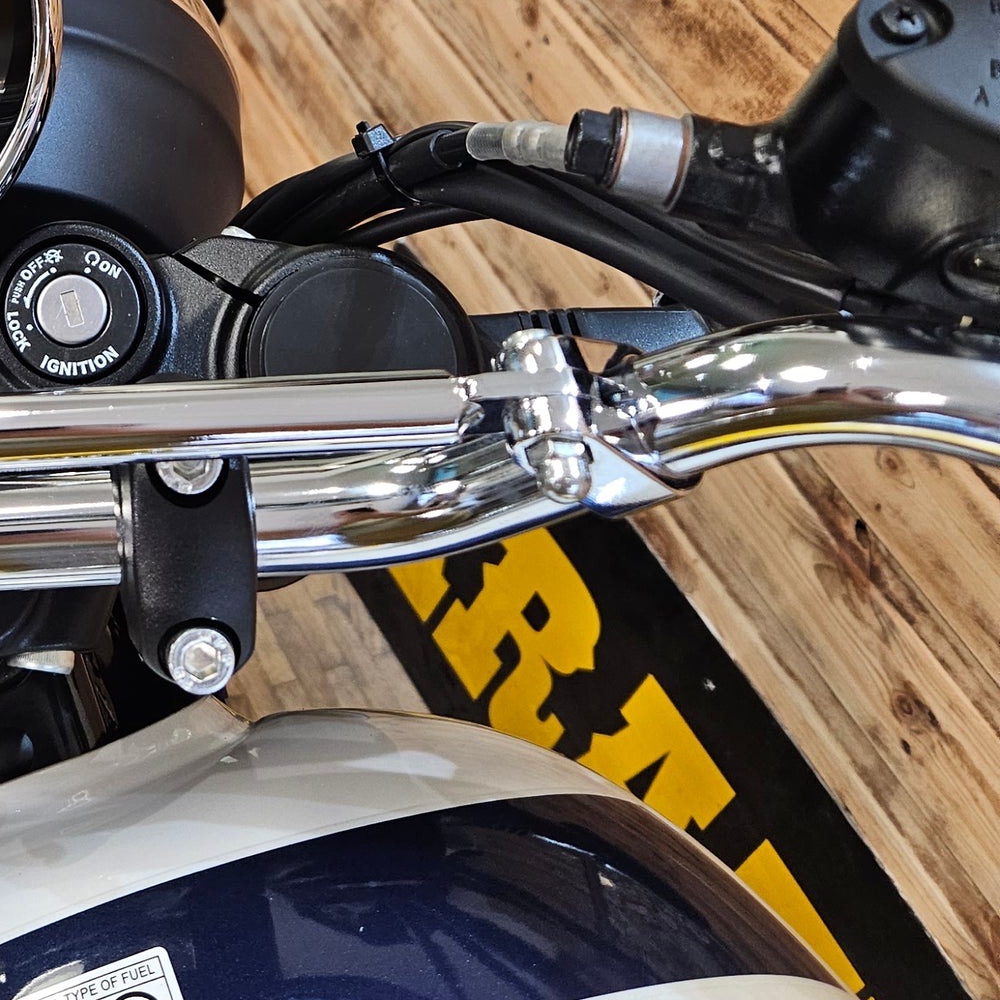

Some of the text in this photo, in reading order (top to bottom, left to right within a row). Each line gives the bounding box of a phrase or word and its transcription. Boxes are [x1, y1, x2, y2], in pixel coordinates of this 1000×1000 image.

[19, 256, 47, 282] OFF
[99, 262, 122, 280] ON
[11, 280, 26, 305] PUSH
[6, 310, 32, 353] LOCK
[39, 345, 120, 377] IGNITION
[64, 964, 156, 1000] TYPE OF FUEL
